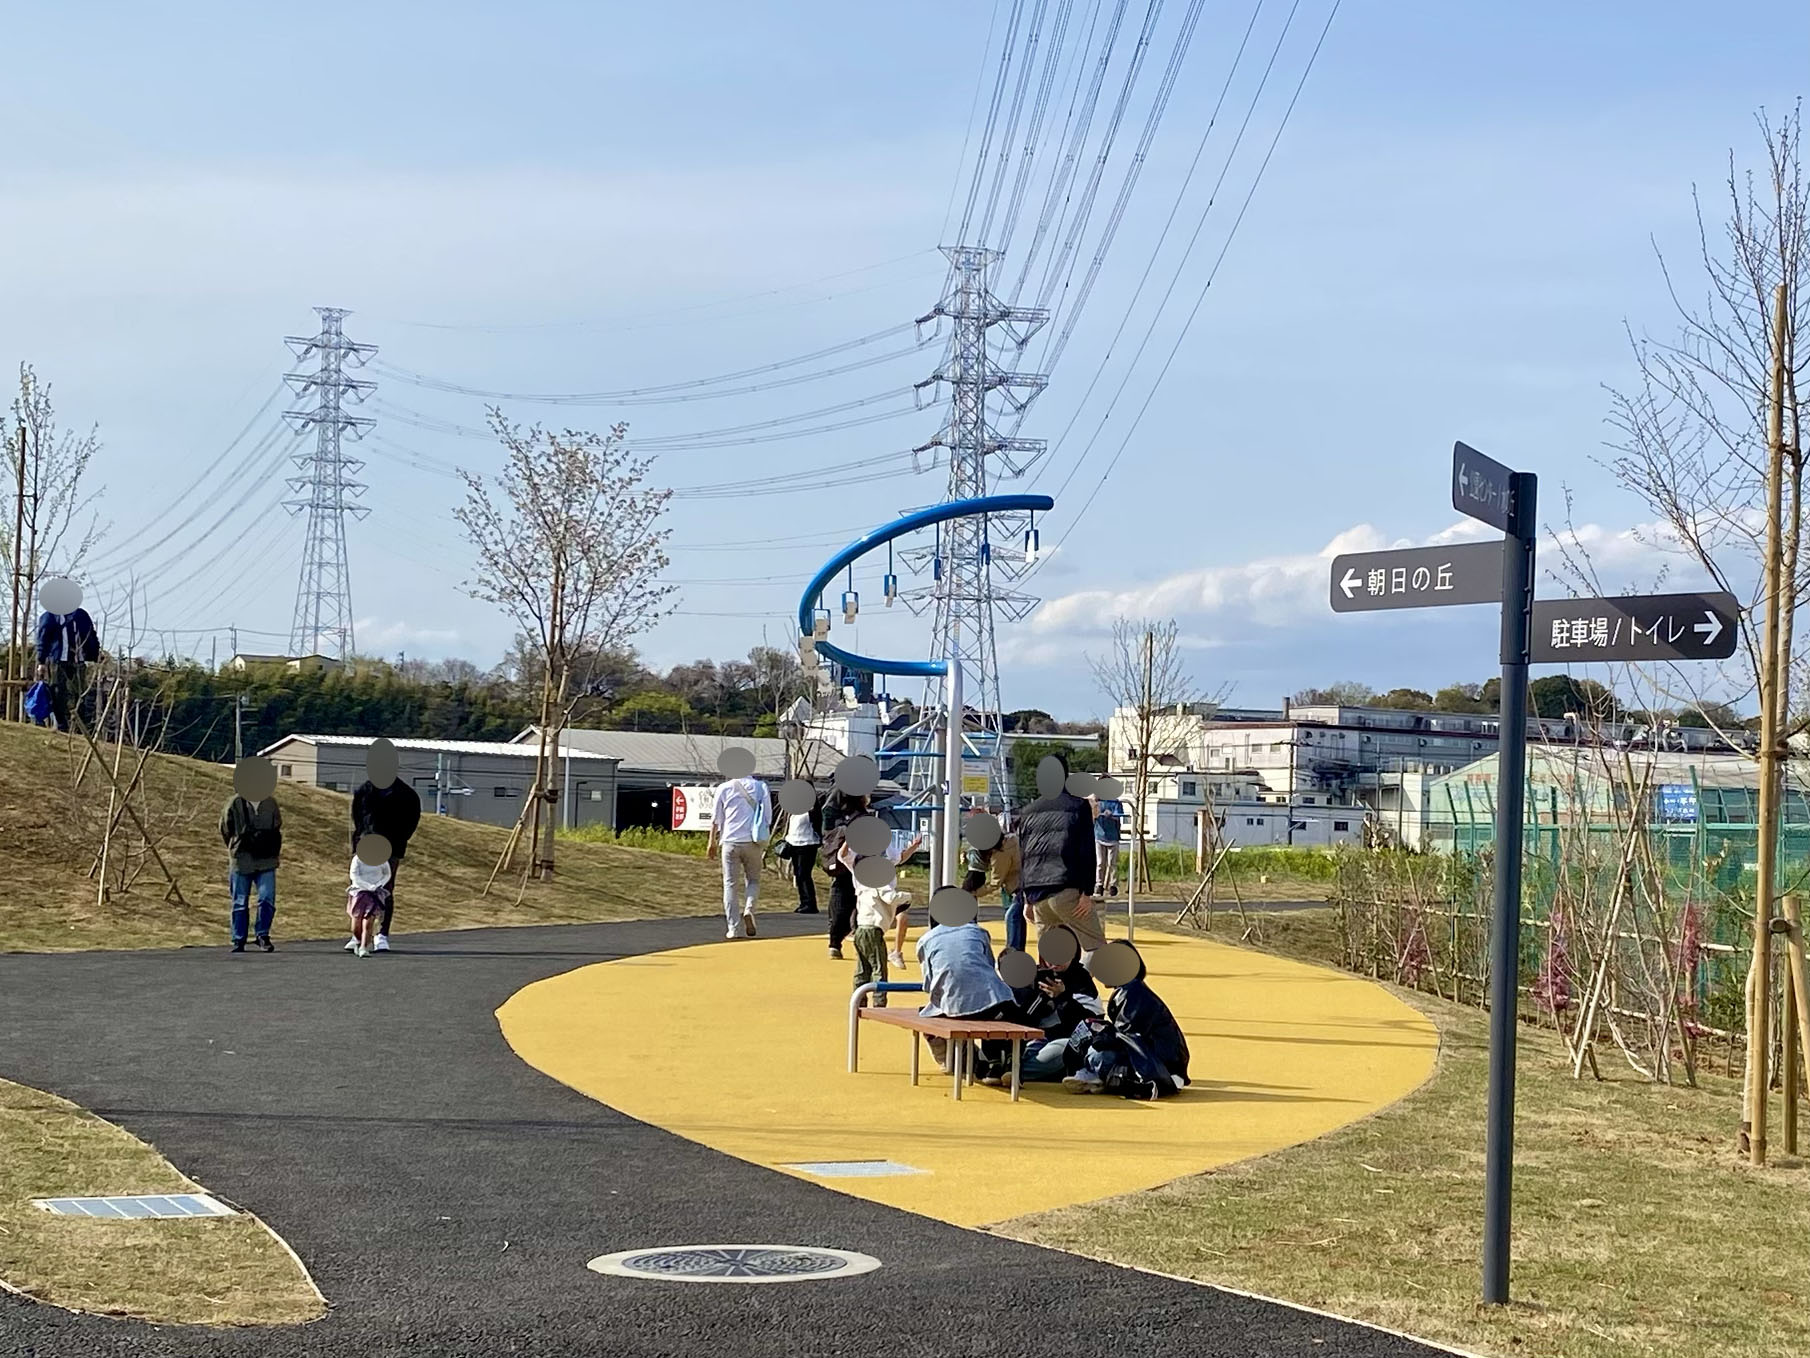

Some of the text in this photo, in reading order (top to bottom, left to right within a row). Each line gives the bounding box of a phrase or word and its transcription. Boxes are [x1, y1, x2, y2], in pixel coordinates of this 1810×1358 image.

[1367, 563, 1454, 596] 朝日の丘
[1551, 615, 1685, 649] 駐車場/トイレ
